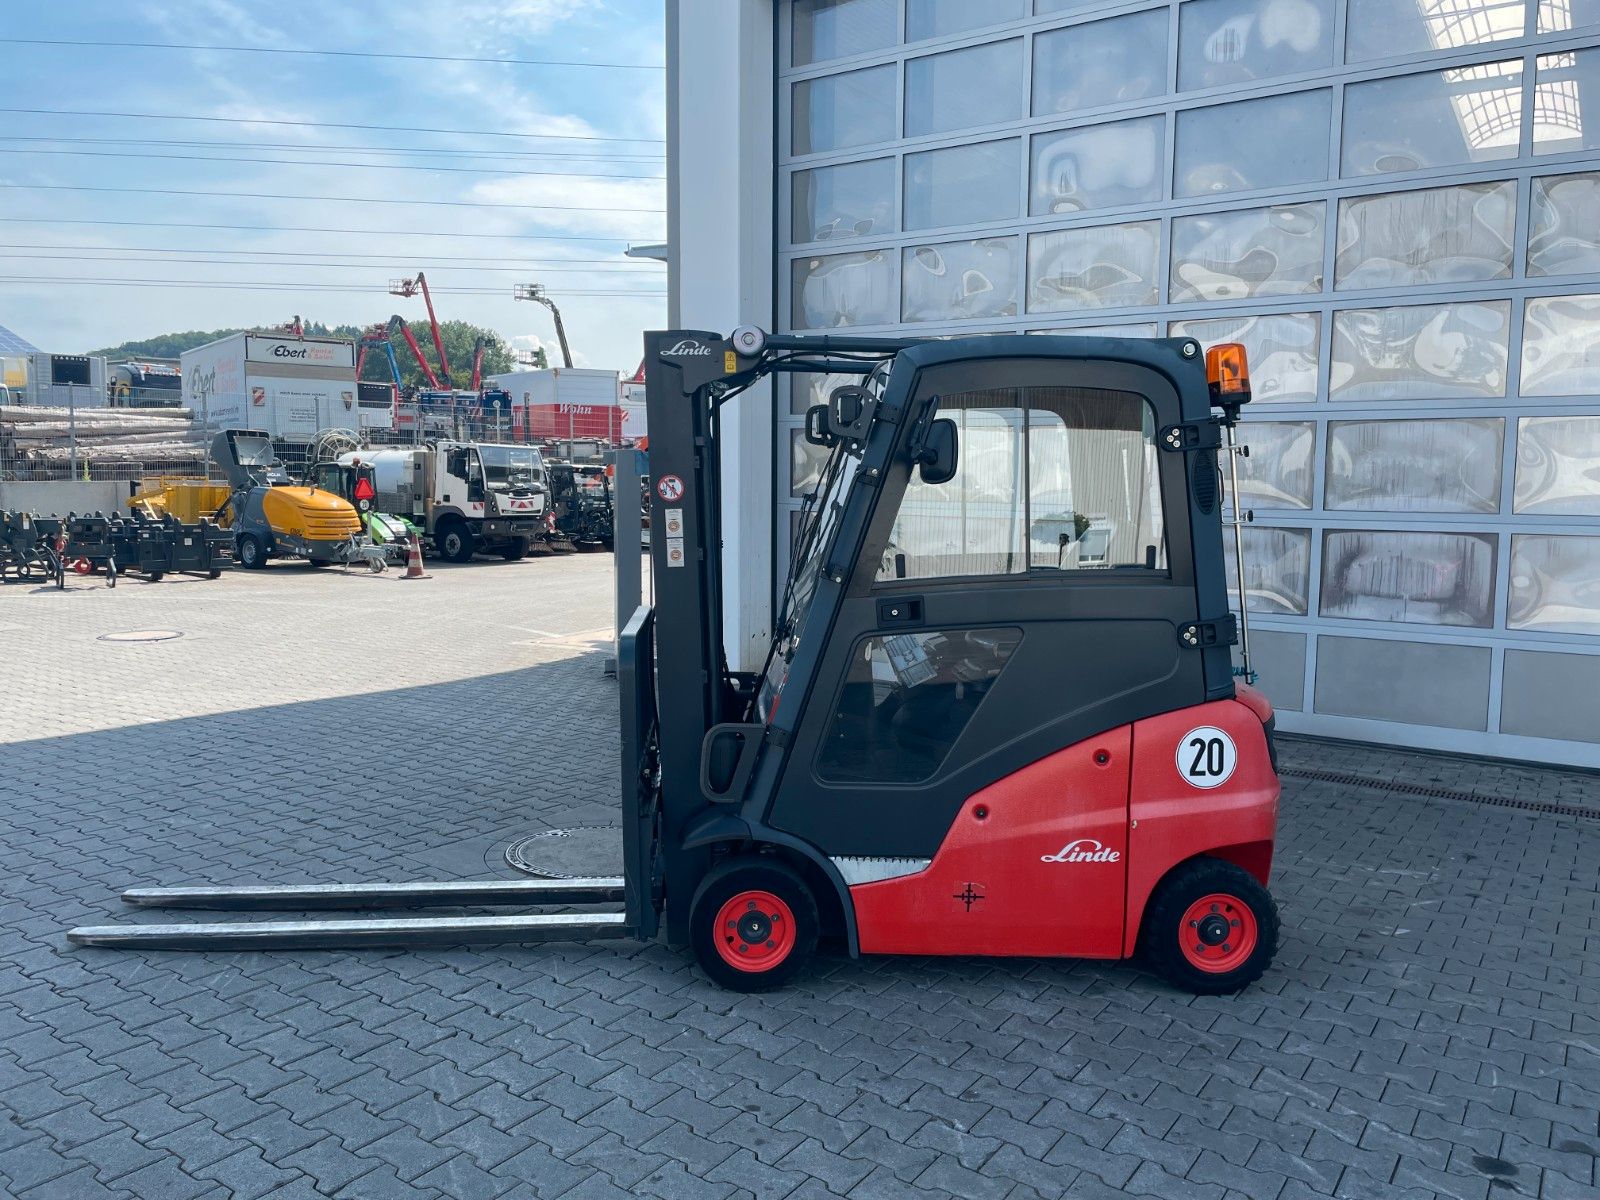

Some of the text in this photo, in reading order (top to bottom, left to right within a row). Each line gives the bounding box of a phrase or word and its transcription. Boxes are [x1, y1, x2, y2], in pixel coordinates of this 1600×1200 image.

[274, 345, 307, 358] Ebert
[660, 340, 712, 356] Linde
[559, 403, 592, 415] Wohn
[1189, 737, 1225, 776] 20
[1040, 839, 1120, 863] Linde
